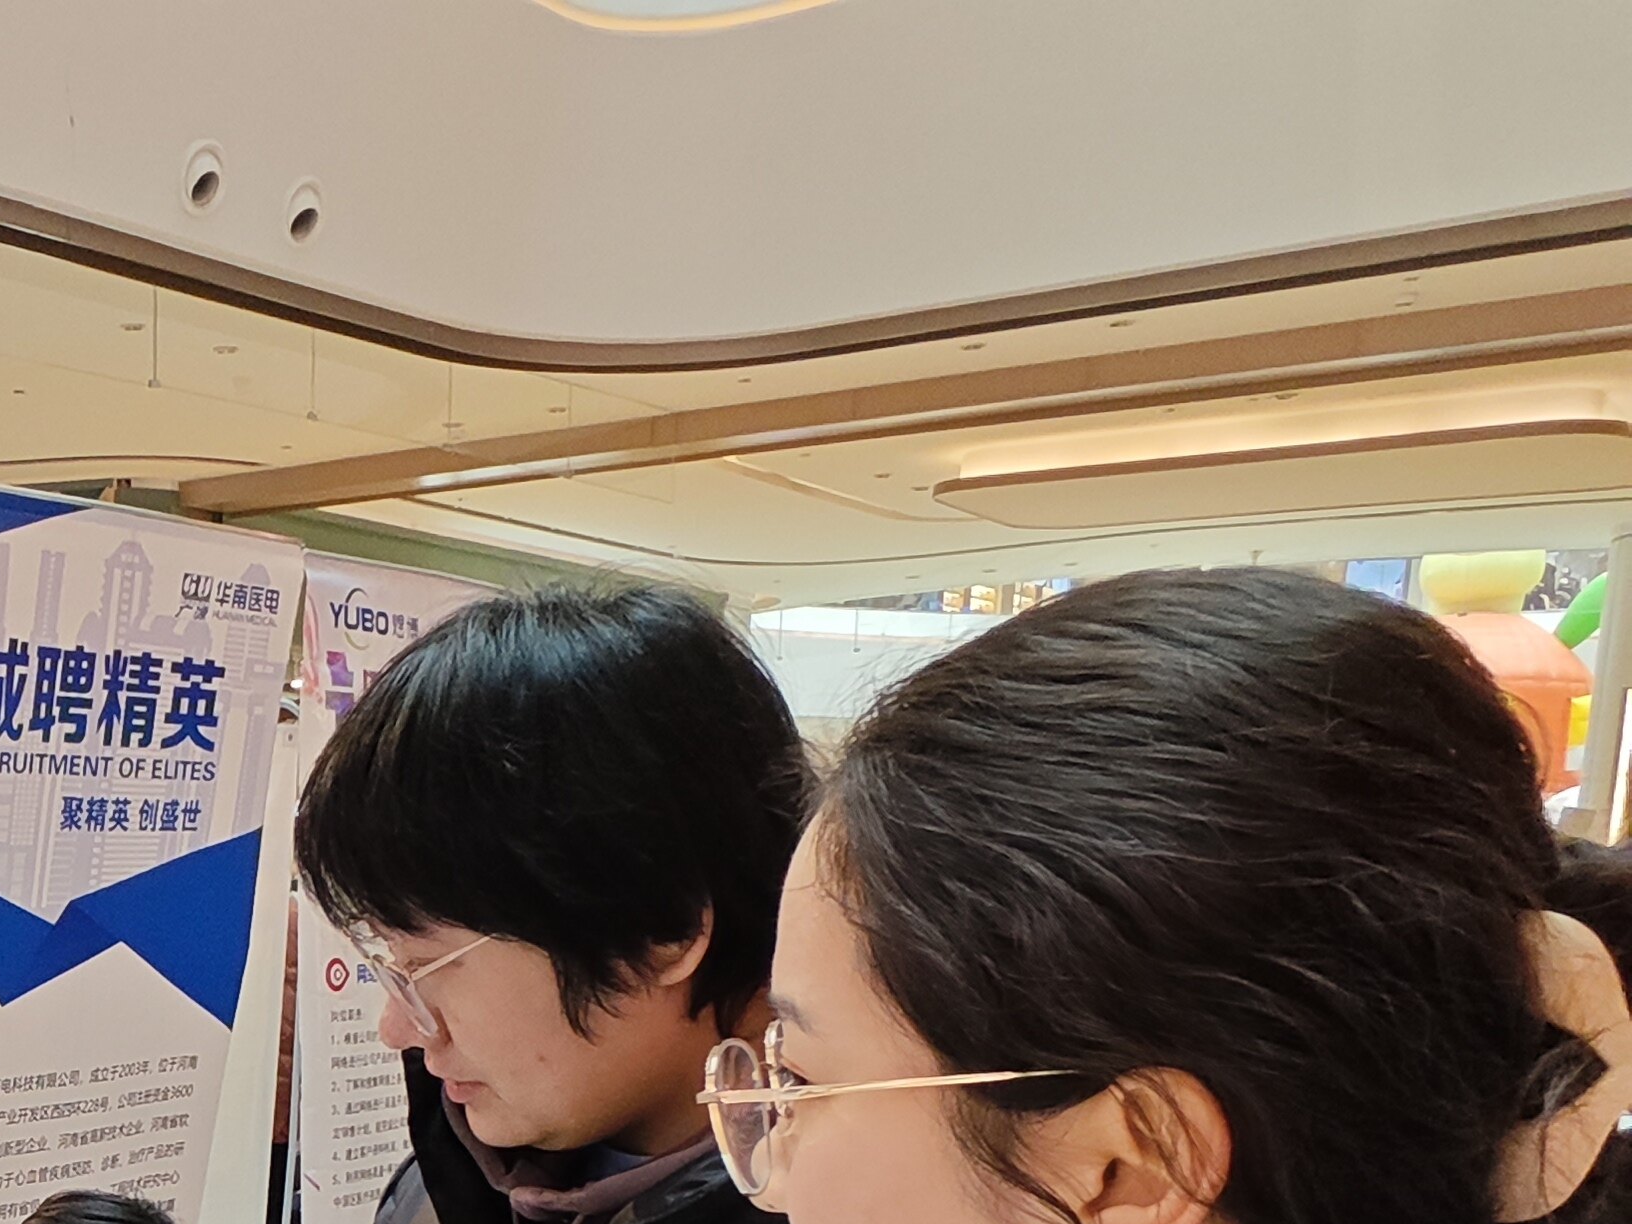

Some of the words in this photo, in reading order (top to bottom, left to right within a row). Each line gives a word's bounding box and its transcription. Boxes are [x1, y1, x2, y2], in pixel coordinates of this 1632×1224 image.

[215, 580, 280, 615] 华南医电
[329, 602, 389, 635] YUBO
[118, 757, 147, 778] OF
[151, 759, 216, 781] ELITES
[60, 796, 131, 831] 聚精英
[138, 799, 201, 831] 创盛世
